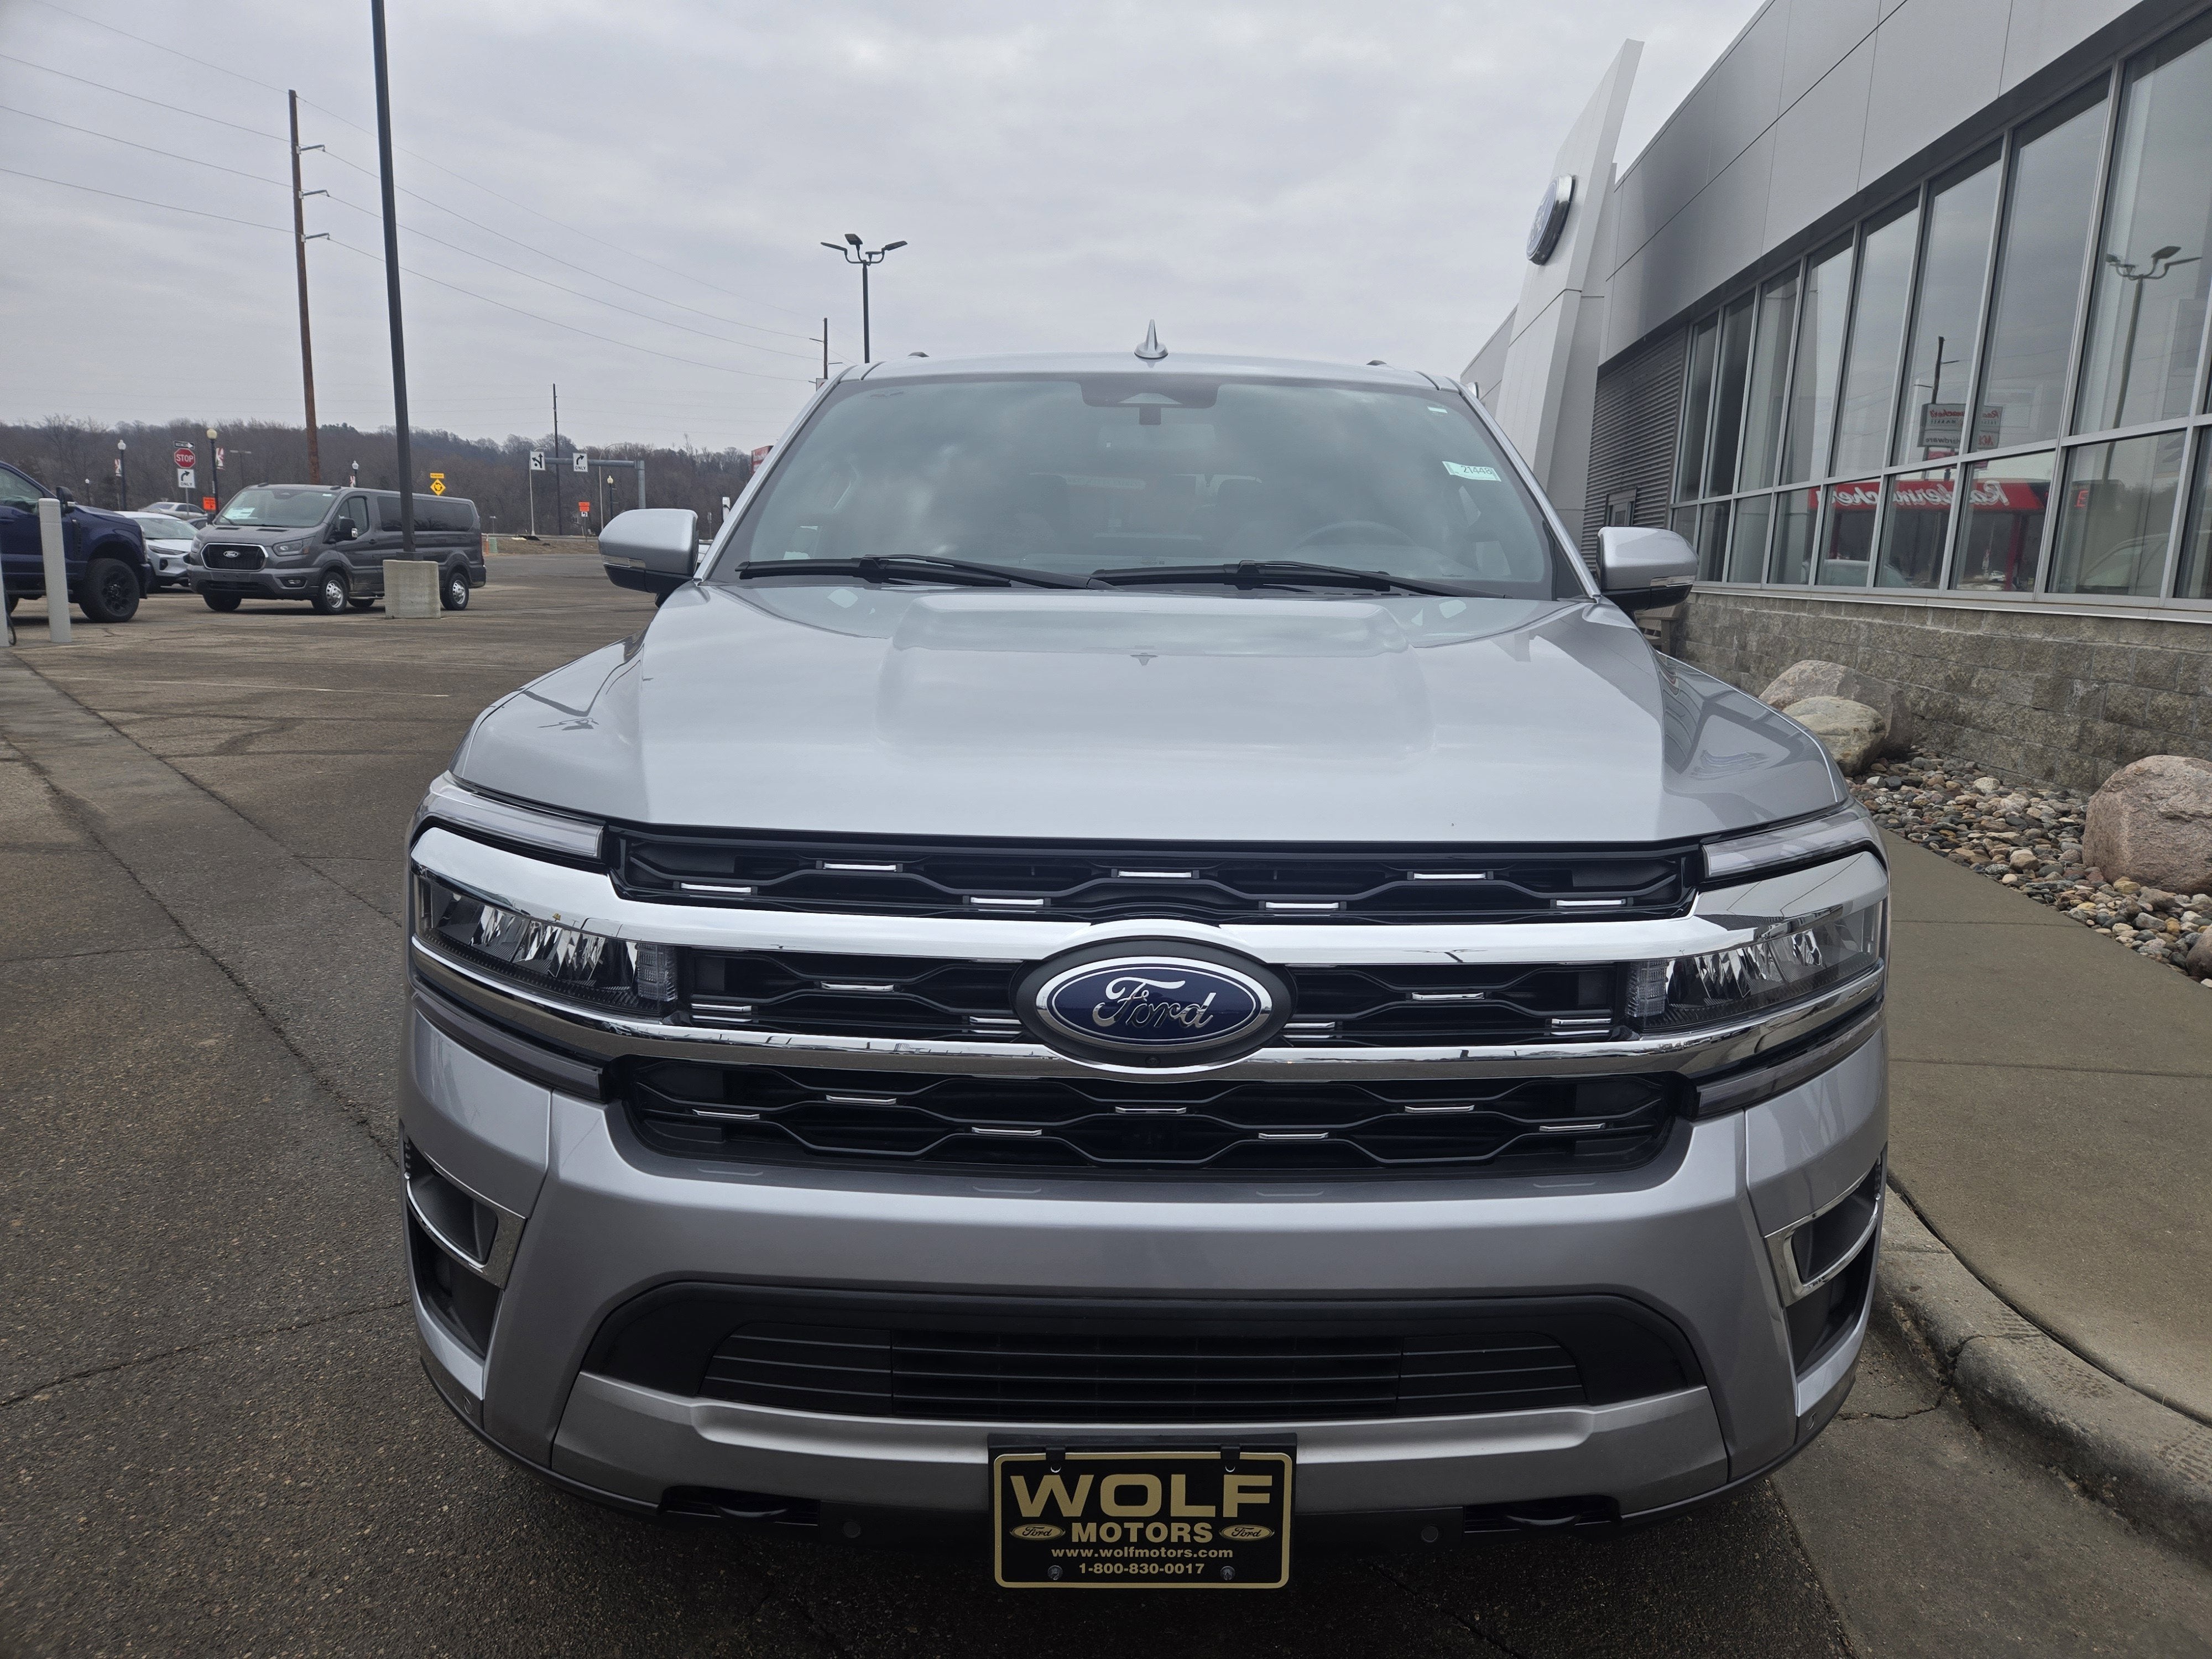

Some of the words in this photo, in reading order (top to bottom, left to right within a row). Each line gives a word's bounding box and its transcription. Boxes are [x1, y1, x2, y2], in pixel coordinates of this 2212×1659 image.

[176, 454, 194, 462] STOP
[1461, 466, 1493, 474] 21448
[1092, 976, 1217, 1029] Ford
[1010, 1474, 1273, 1517] WOLF
[1022, 1526, 1052, 1538] Ford
[1071, 1522, 1213, 1543] MOTORS
[1232, 1526, 1261, 1538] Ford
[1051, 1546, 1233, 1558] www.wolfmotors.com
[1079, 1563, 1205, 1574] 1-800-830-0017
